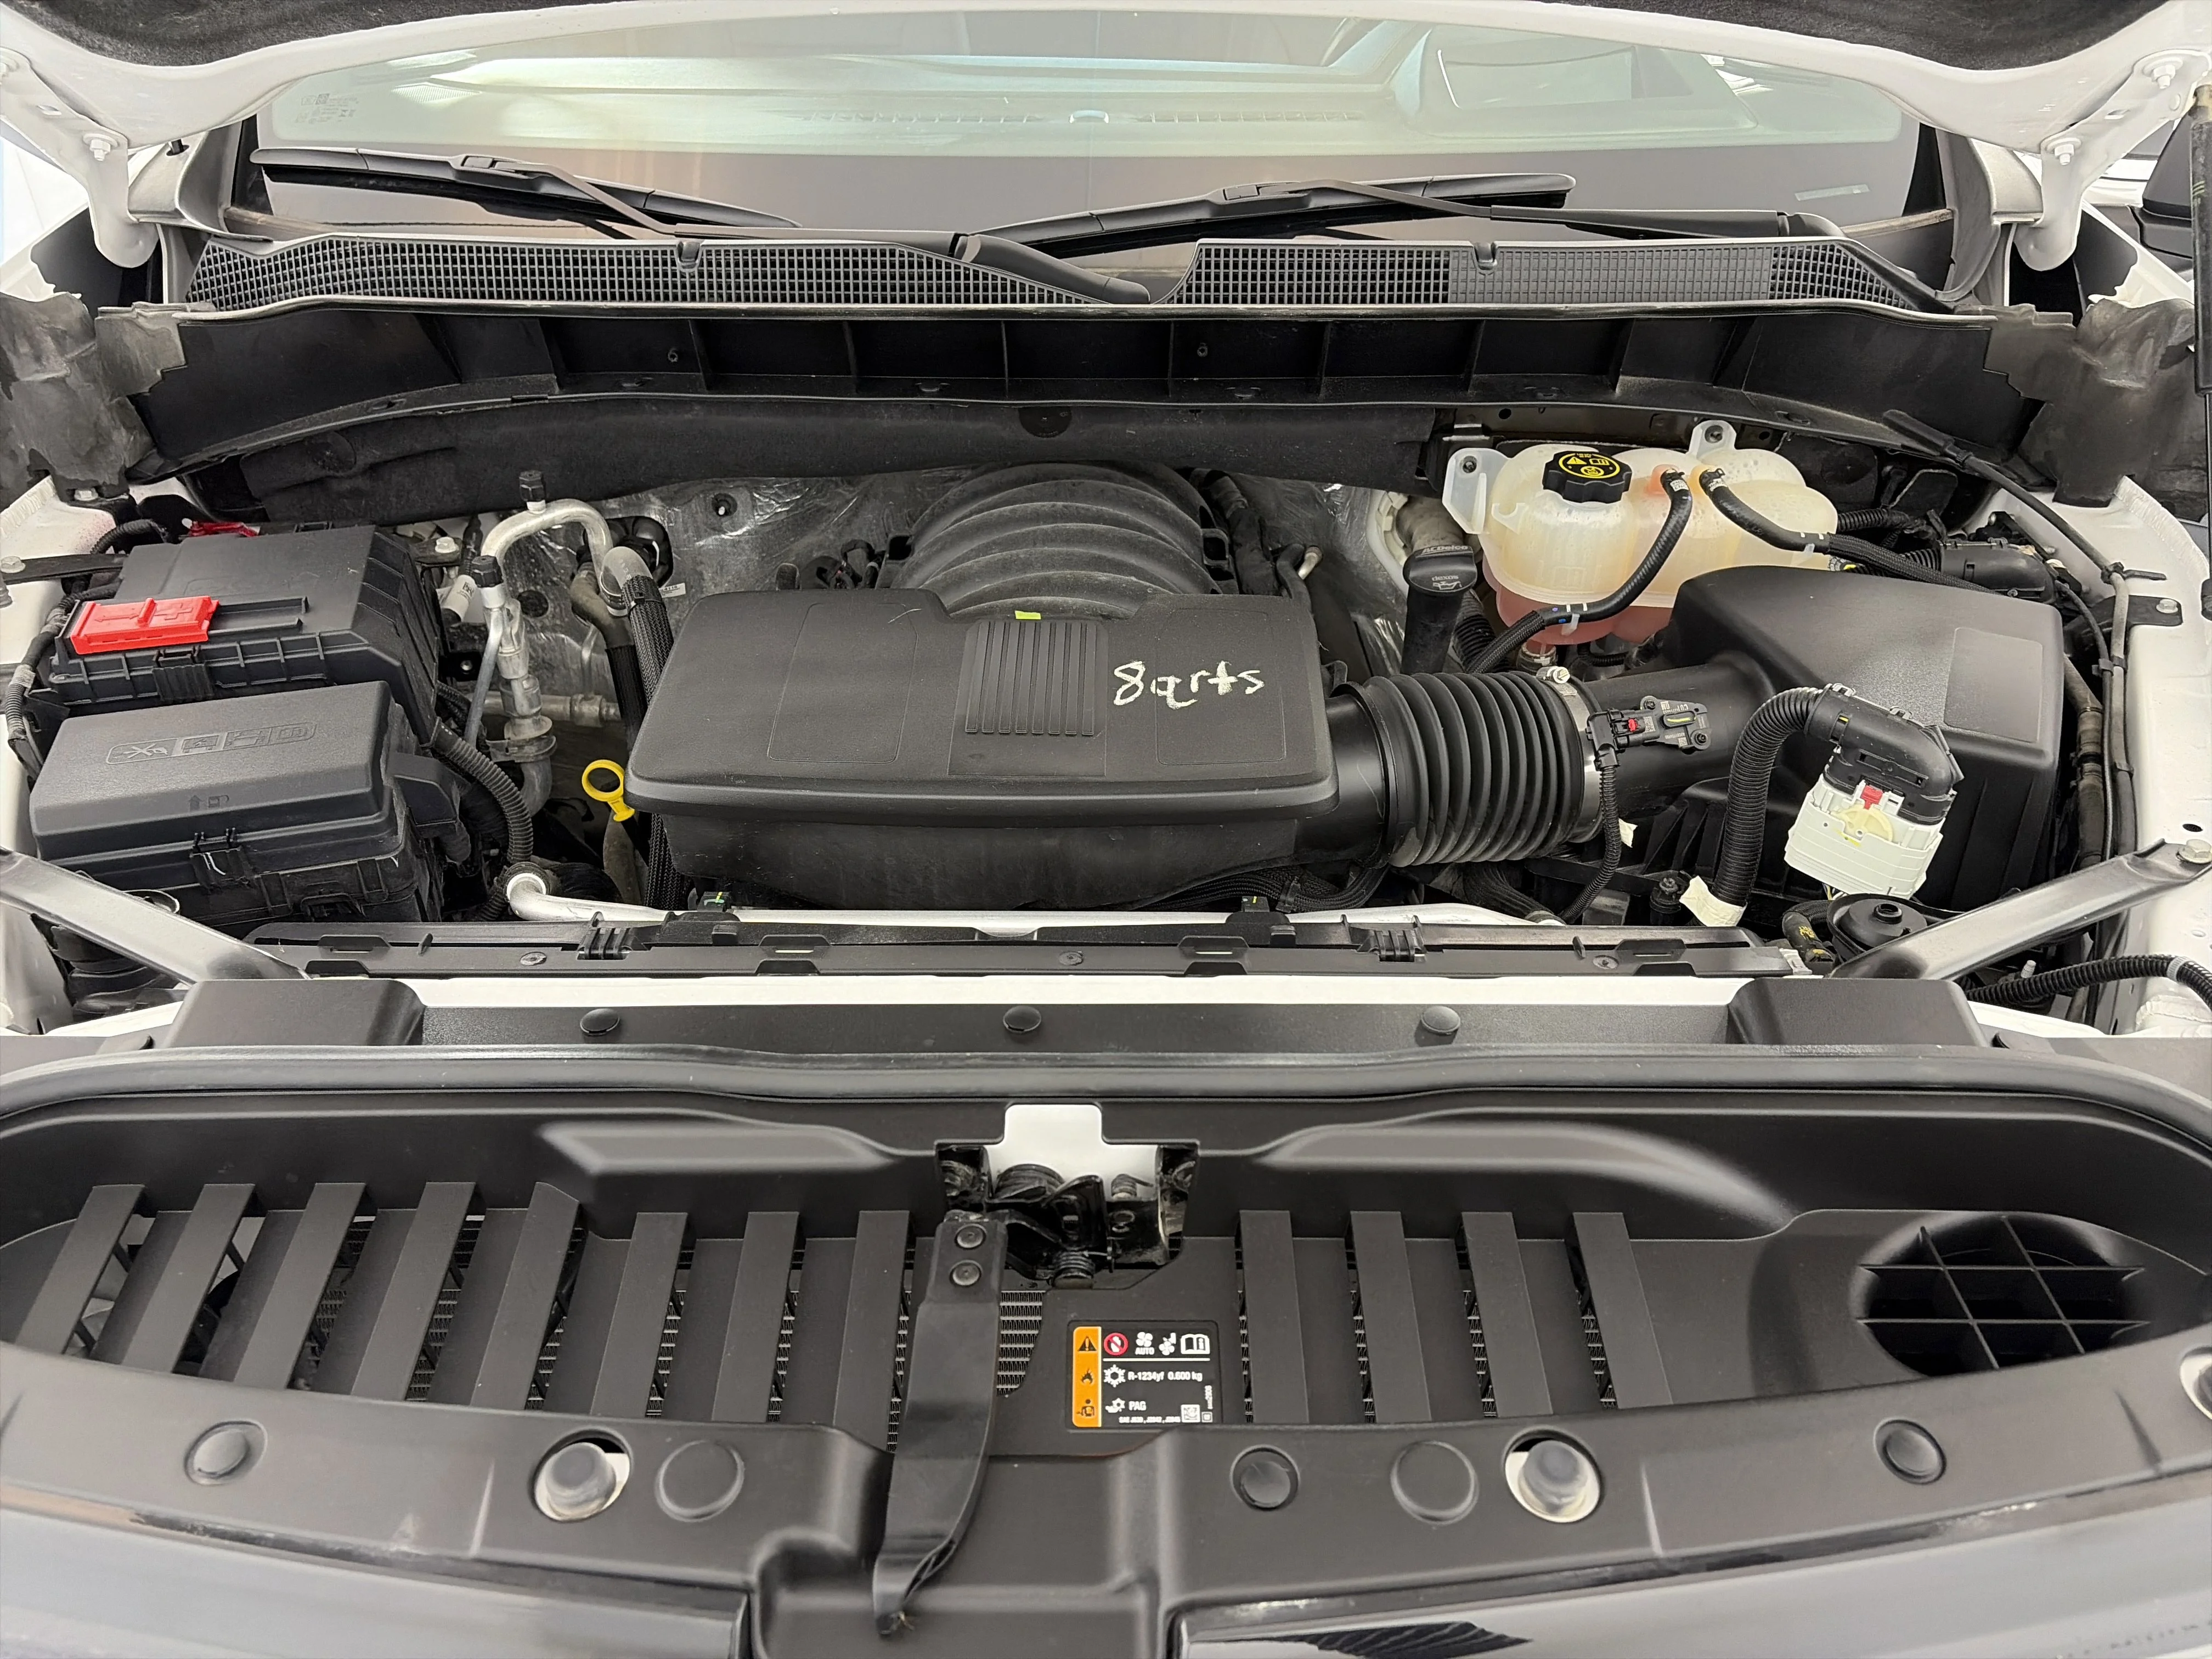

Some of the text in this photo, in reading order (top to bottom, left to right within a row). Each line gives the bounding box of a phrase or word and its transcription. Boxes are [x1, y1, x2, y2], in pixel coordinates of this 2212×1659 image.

[1421, 545, 1468, 554] ACDelco
[1135, 1347, 1155, 1355] AUTO
[1127, 1371, 1165, 1382] R-1234yf
[1192, 1371, 1203, 1382] kg
[1128, 1401, 1147, 1410] PAG
